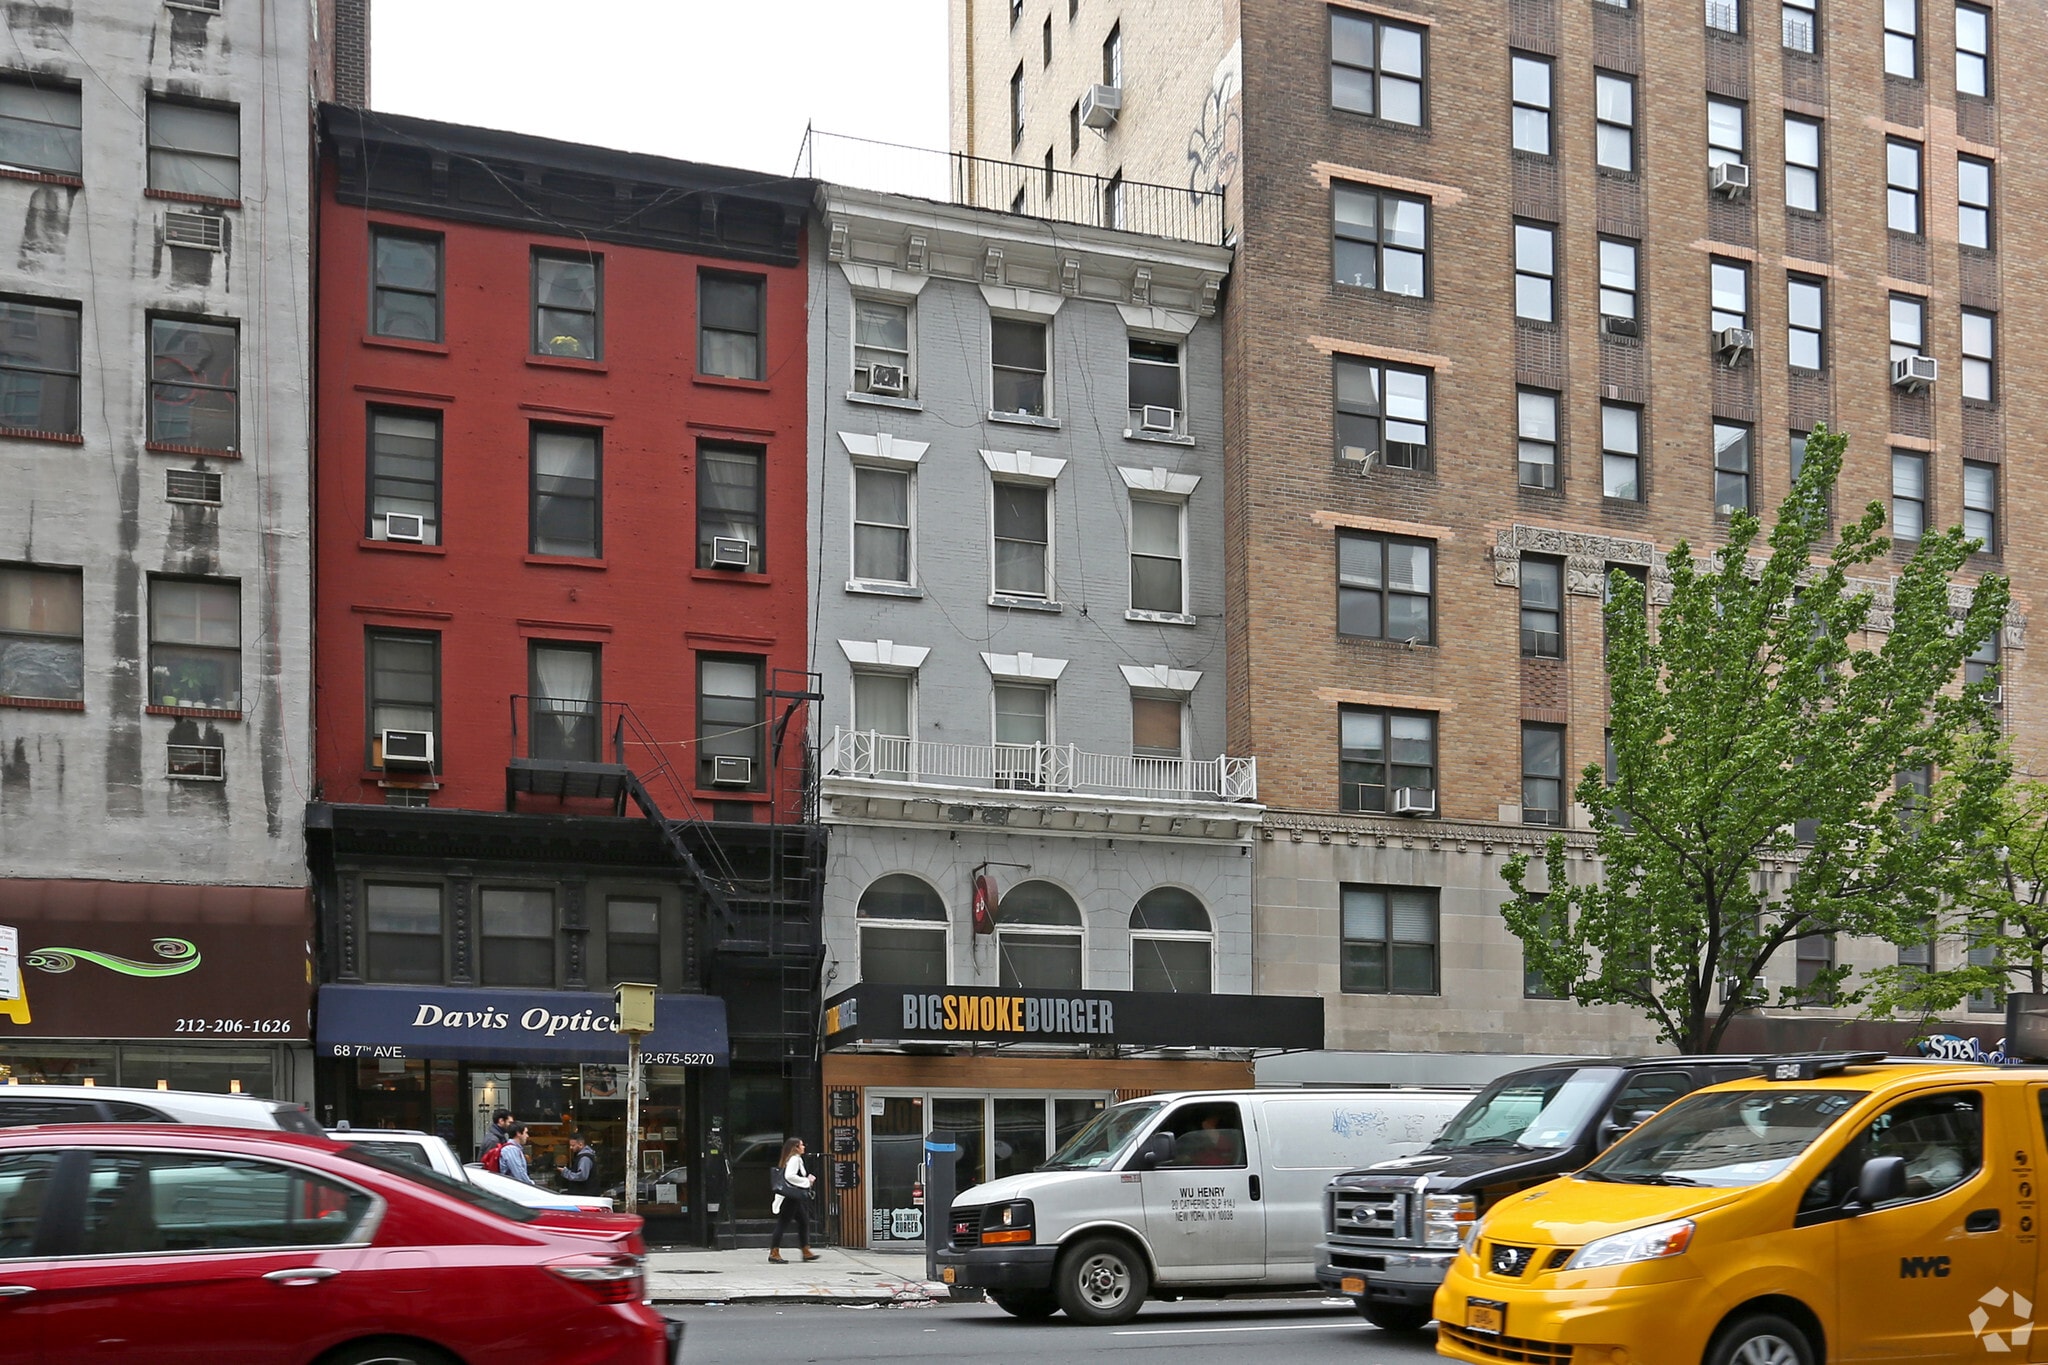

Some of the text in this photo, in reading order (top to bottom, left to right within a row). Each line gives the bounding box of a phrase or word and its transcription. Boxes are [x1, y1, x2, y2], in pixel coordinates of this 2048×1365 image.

[412, 1004, 617, 1037] Davis Optic
[902, 994, 1114, 1034] BIGSMOKEBURGER
[174, 1018, 291, 1033] 212-206-1626
[333, 1044, 406, 1058] 68 7TH AVE.
[639, 1053, 714, 1065] 12-675-5270
[1179, 1187, 1225, 1198] WU HENRY
[1175, 1211, 1188, 1221] NEW
[1208, 1211, 1216, 1220] NY
[895, 1221, 918, 1233] BURGER
[1900, 1256, 1950, 1278] NYC
